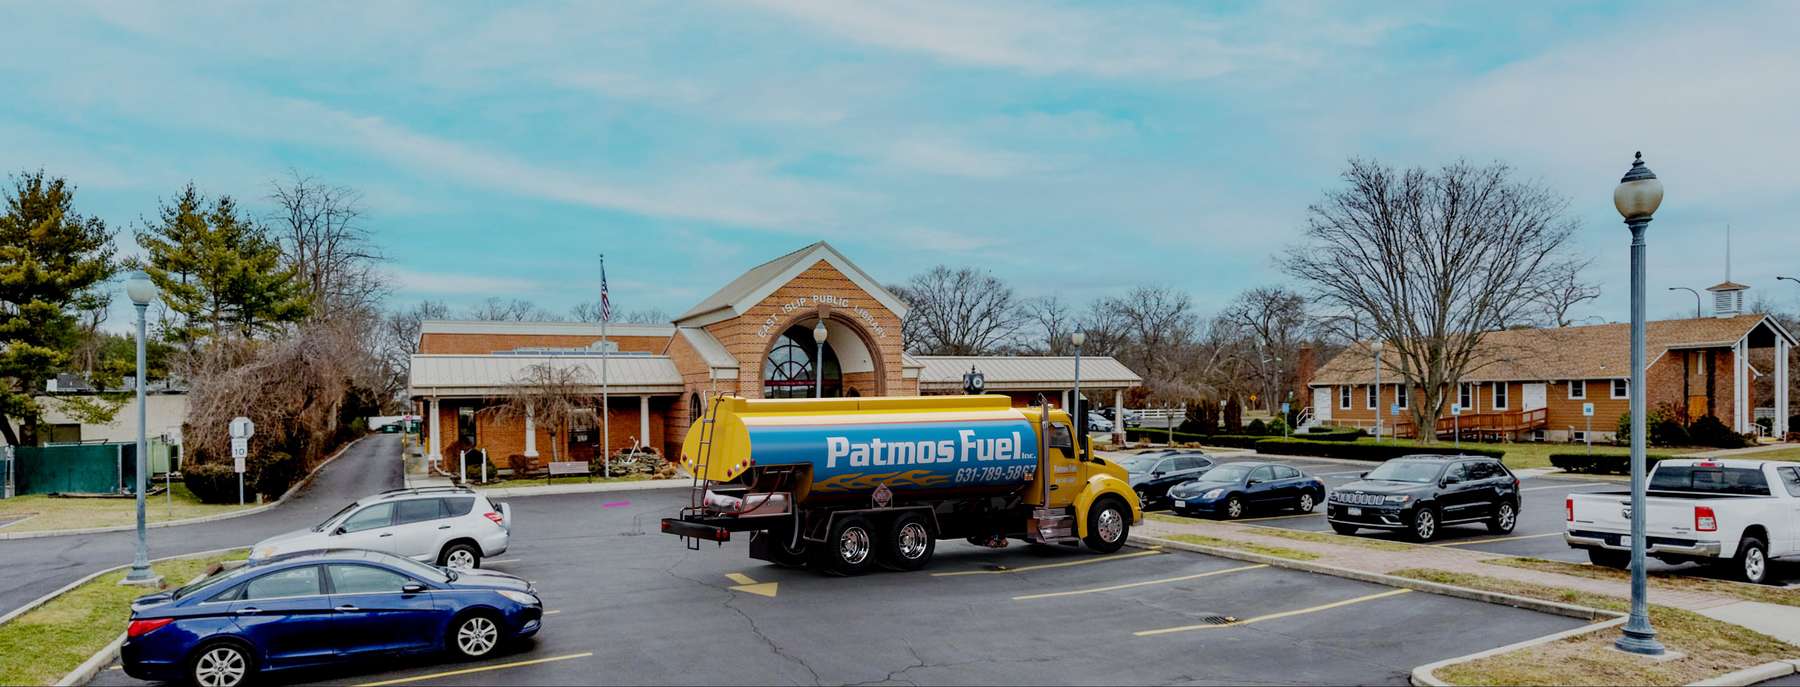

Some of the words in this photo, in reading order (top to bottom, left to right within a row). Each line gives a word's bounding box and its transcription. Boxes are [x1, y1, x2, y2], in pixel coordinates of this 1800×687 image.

[758, 313, 778, 337] EAST
[782, 297, 806, 314] ISLIP
[812, 294, 849, 307] PUBLIC
[853, 305, 886, 338] LIBRARY
[234, 448, 245, 456] 10
[826, 436, 955, 468] Patmos
[959, 429, 1021, 462] Fuel
